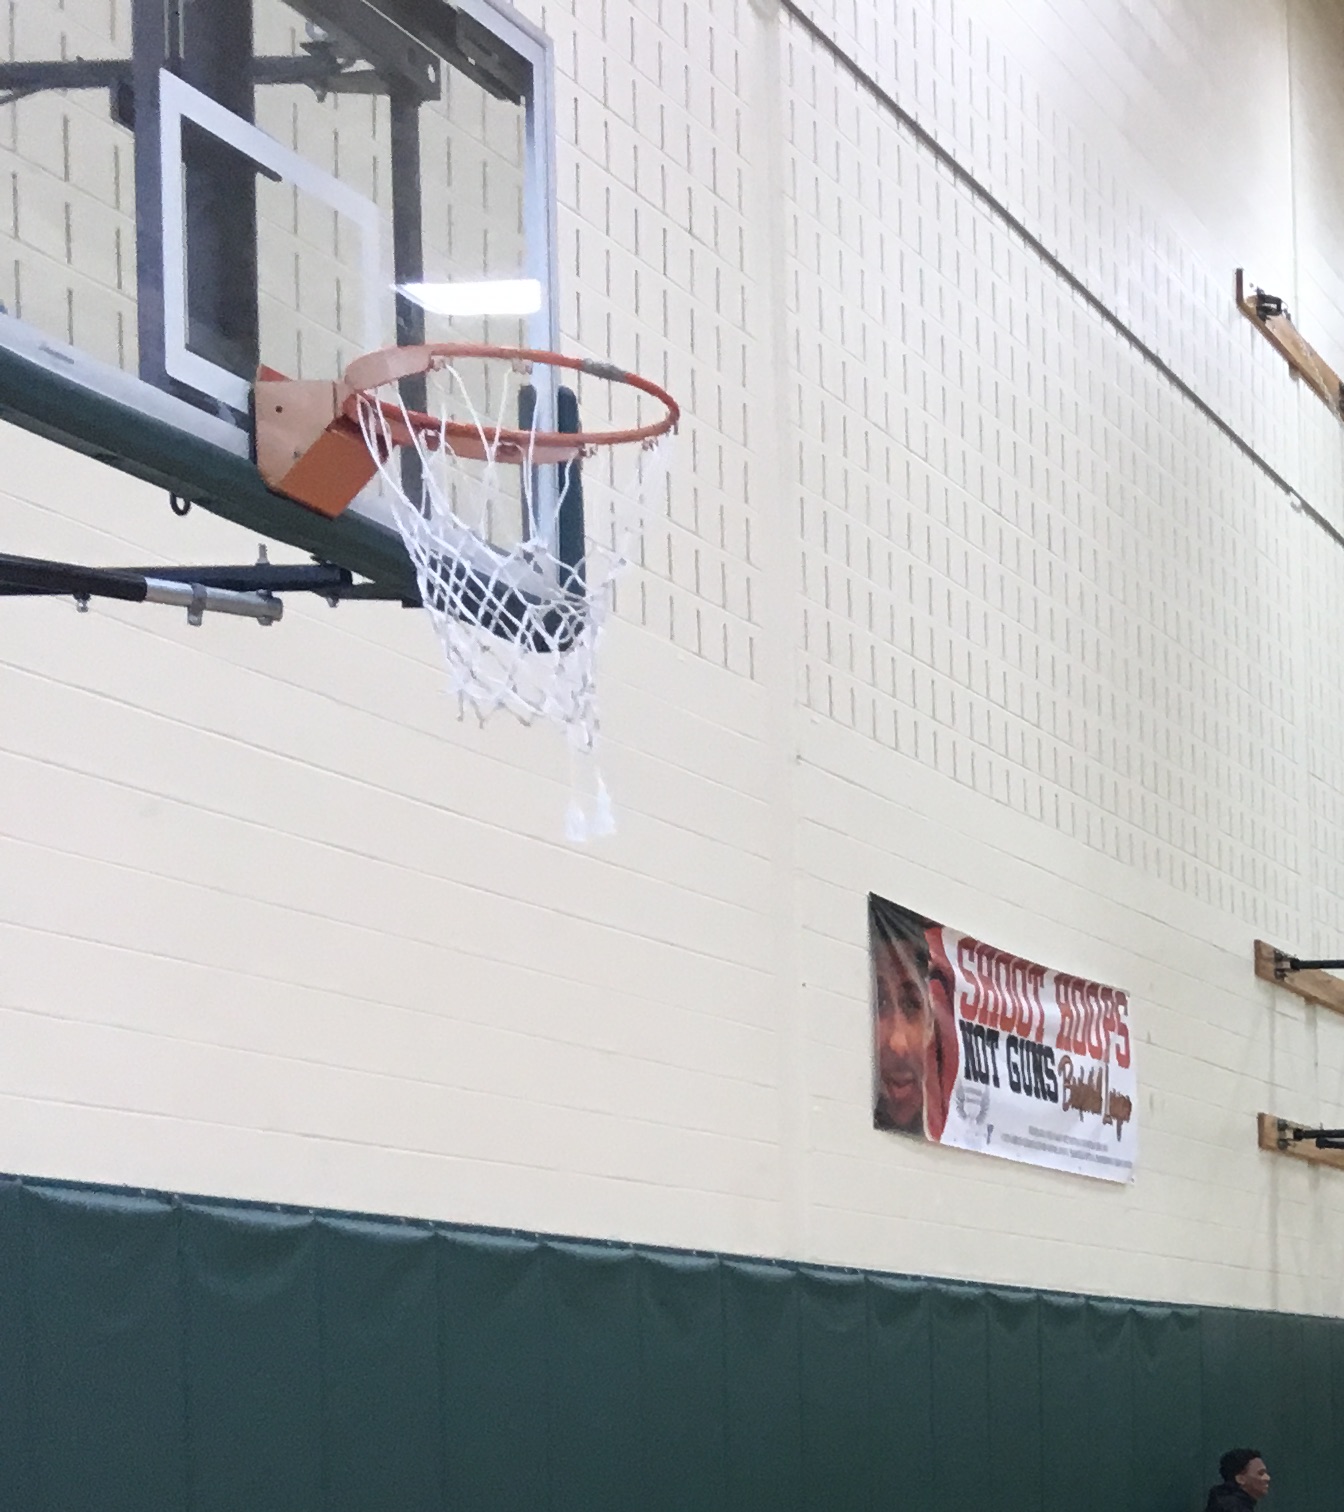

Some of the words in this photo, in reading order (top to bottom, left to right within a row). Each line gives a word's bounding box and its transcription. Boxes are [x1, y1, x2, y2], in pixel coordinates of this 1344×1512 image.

[957, 936, 1047, 1043] SHOOT
[1054, 971, 1131, 1069] HOOPS
[959, 1020, 1001, 1088] NOT
[1005, 1034, 1058, 1103] GUNS
